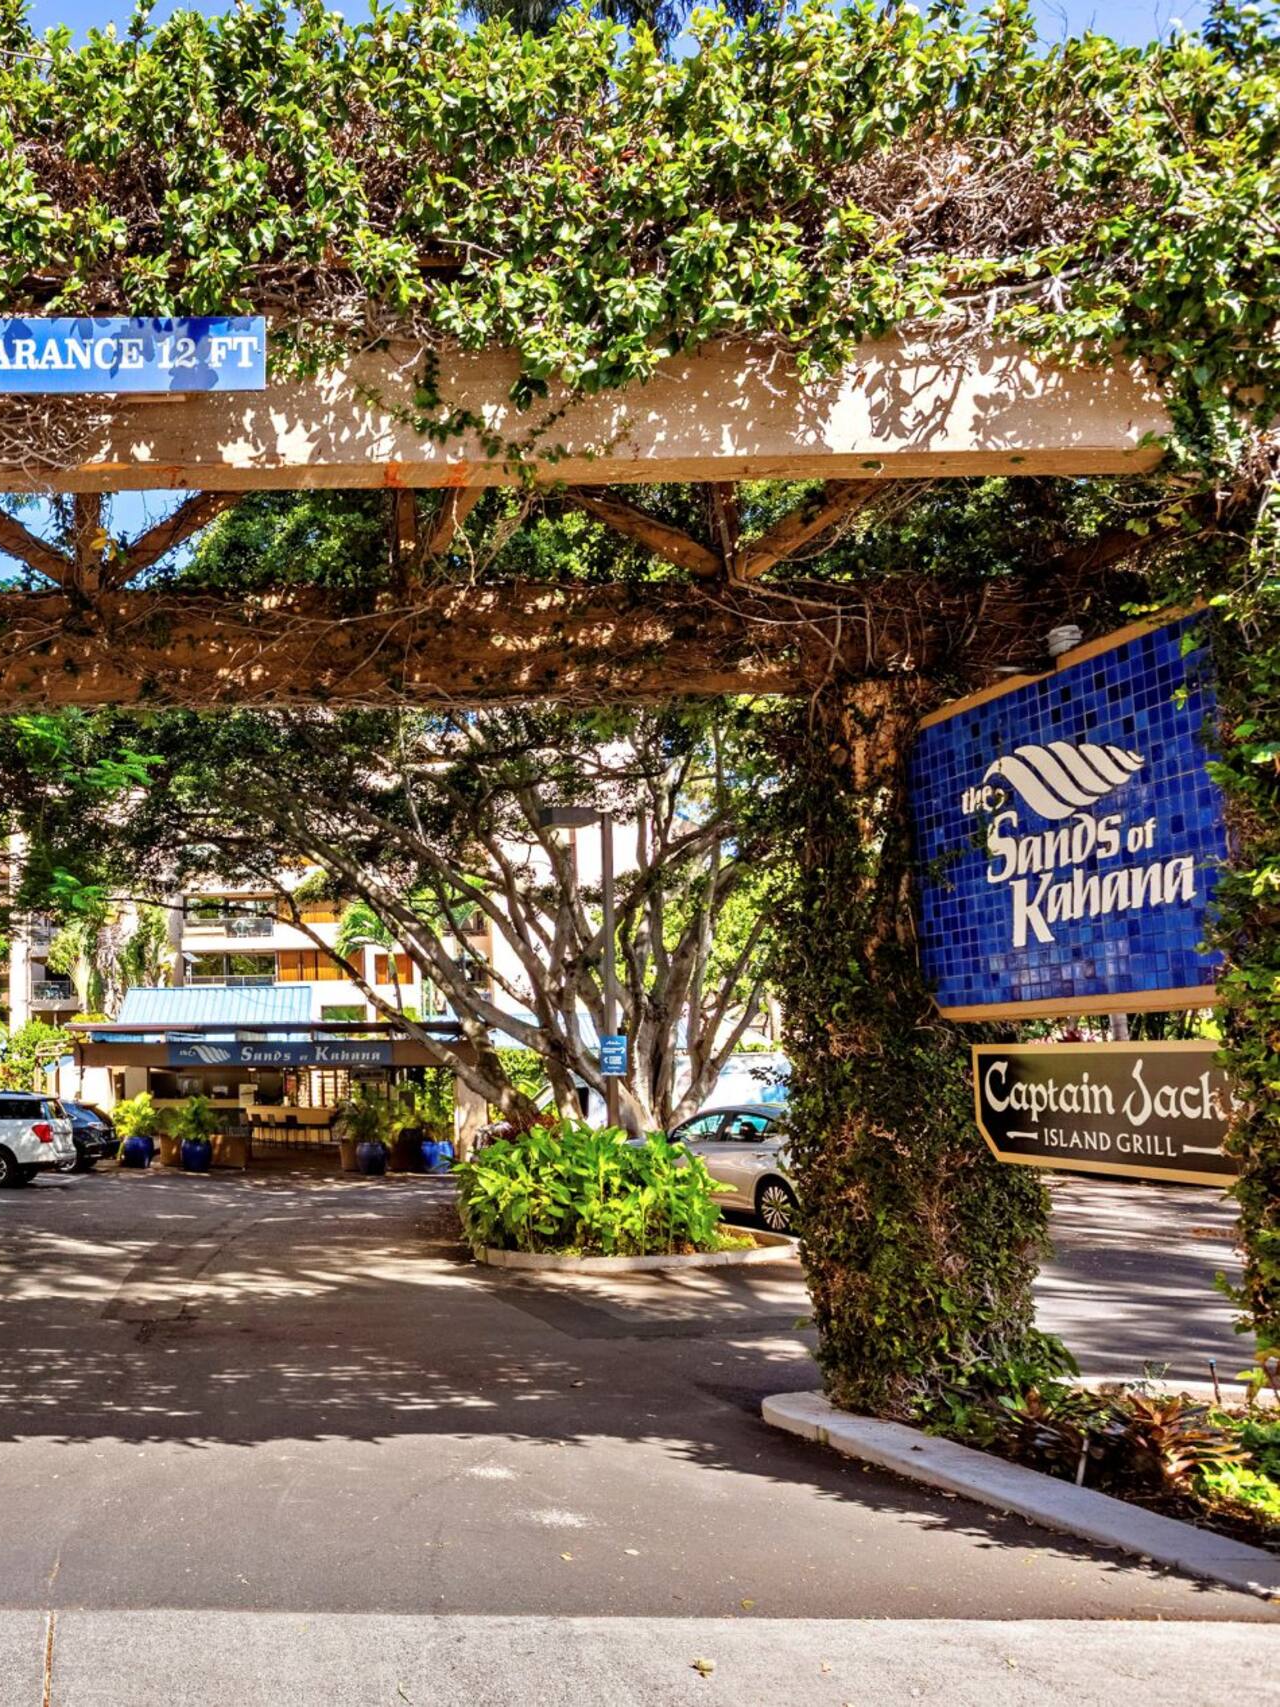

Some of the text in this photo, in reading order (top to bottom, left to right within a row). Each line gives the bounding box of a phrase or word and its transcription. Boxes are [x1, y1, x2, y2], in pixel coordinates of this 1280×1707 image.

[157, 337, 196, 368] 12
[208, 336, 258, 368] FT
[986, 810, 1157, 884] Sands of
[1010, 854, 1197, 948] Kahana
[240, 1046, 291, 1061] Sands
[314, 1046, 381, 1061] Kahana
[984, 1061, 1116, 1122] Captain
[1043, 1127, 1177, 1157] ISLAND GRILL
